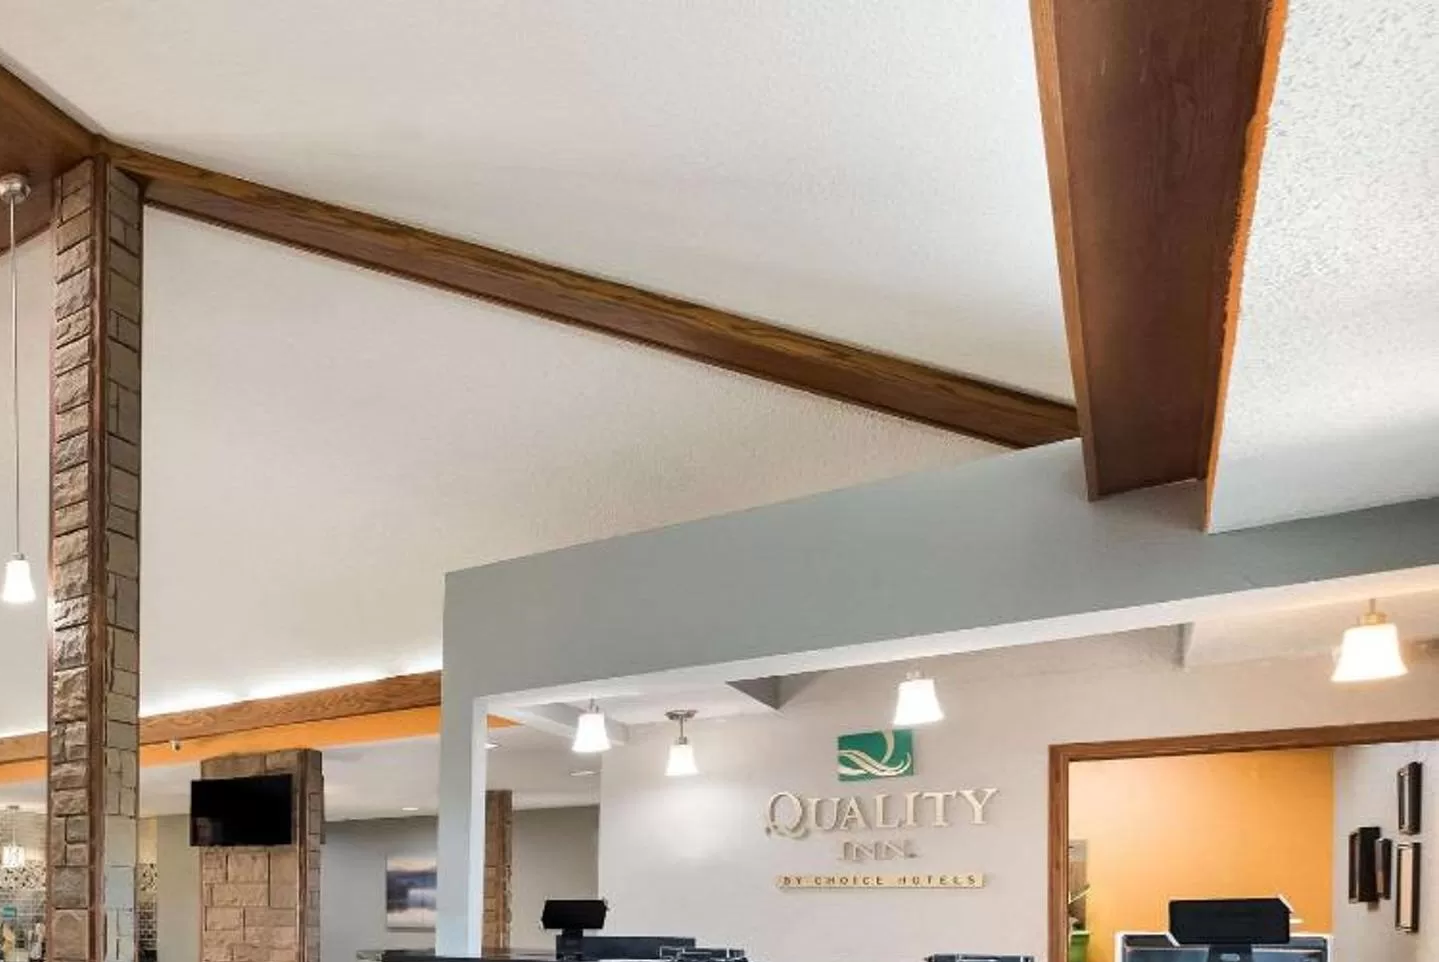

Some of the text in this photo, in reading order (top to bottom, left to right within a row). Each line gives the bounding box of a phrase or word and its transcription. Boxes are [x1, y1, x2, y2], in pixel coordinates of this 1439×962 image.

[765, 788, 999, 839] QUALITY
[838, 840, 920, 862] INN
[783, 875, 977, 886] BY CHOICE HOTELS
